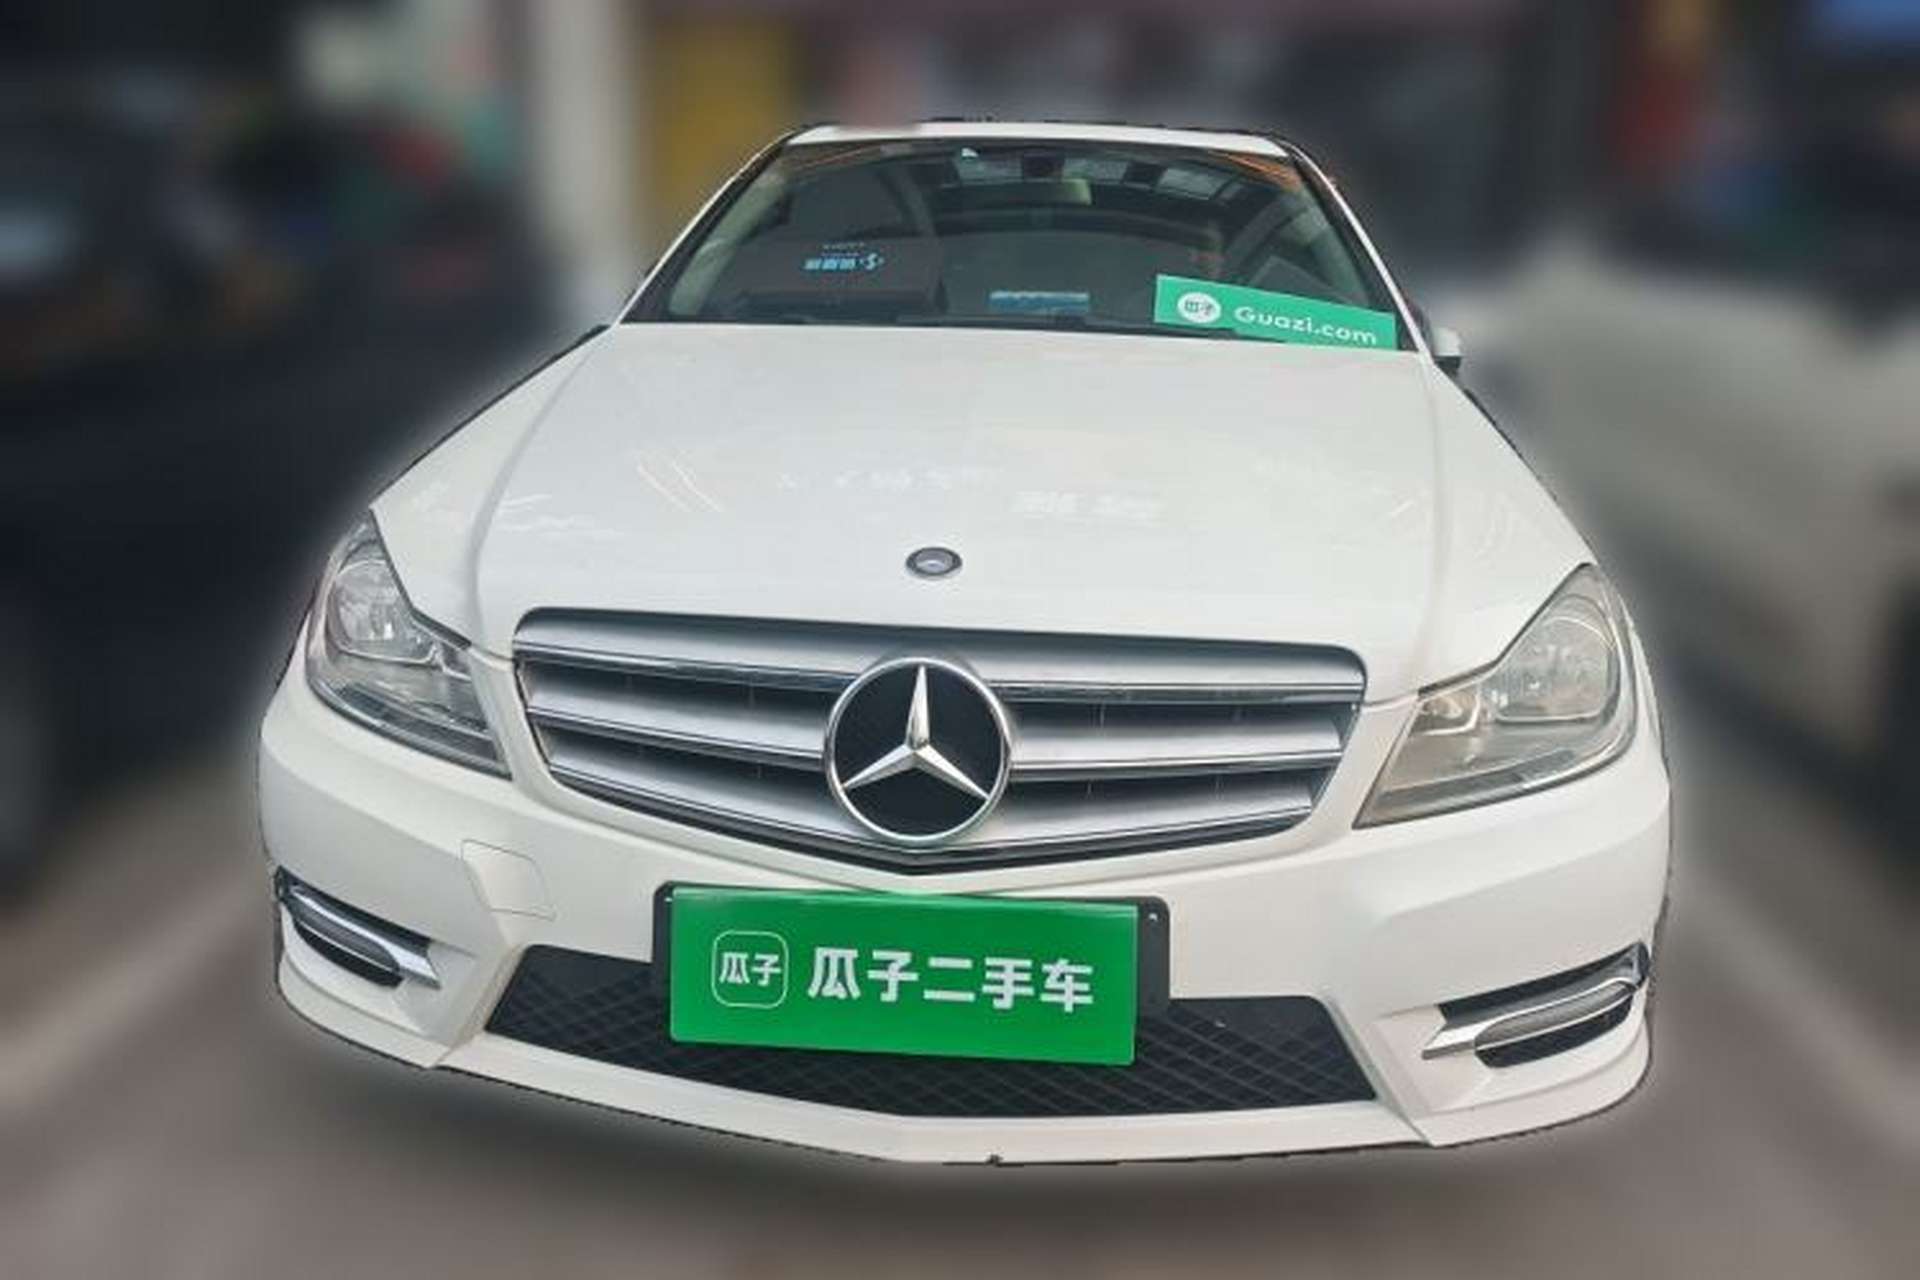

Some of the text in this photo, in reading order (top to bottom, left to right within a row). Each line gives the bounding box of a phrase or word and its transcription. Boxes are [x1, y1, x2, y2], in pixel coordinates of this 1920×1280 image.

[1234, 306, 1377, 345] Guazi.com
[719, 952, 782, 987] 瓜子
[807, 946, 1094, 1012] 瓜子二手车
